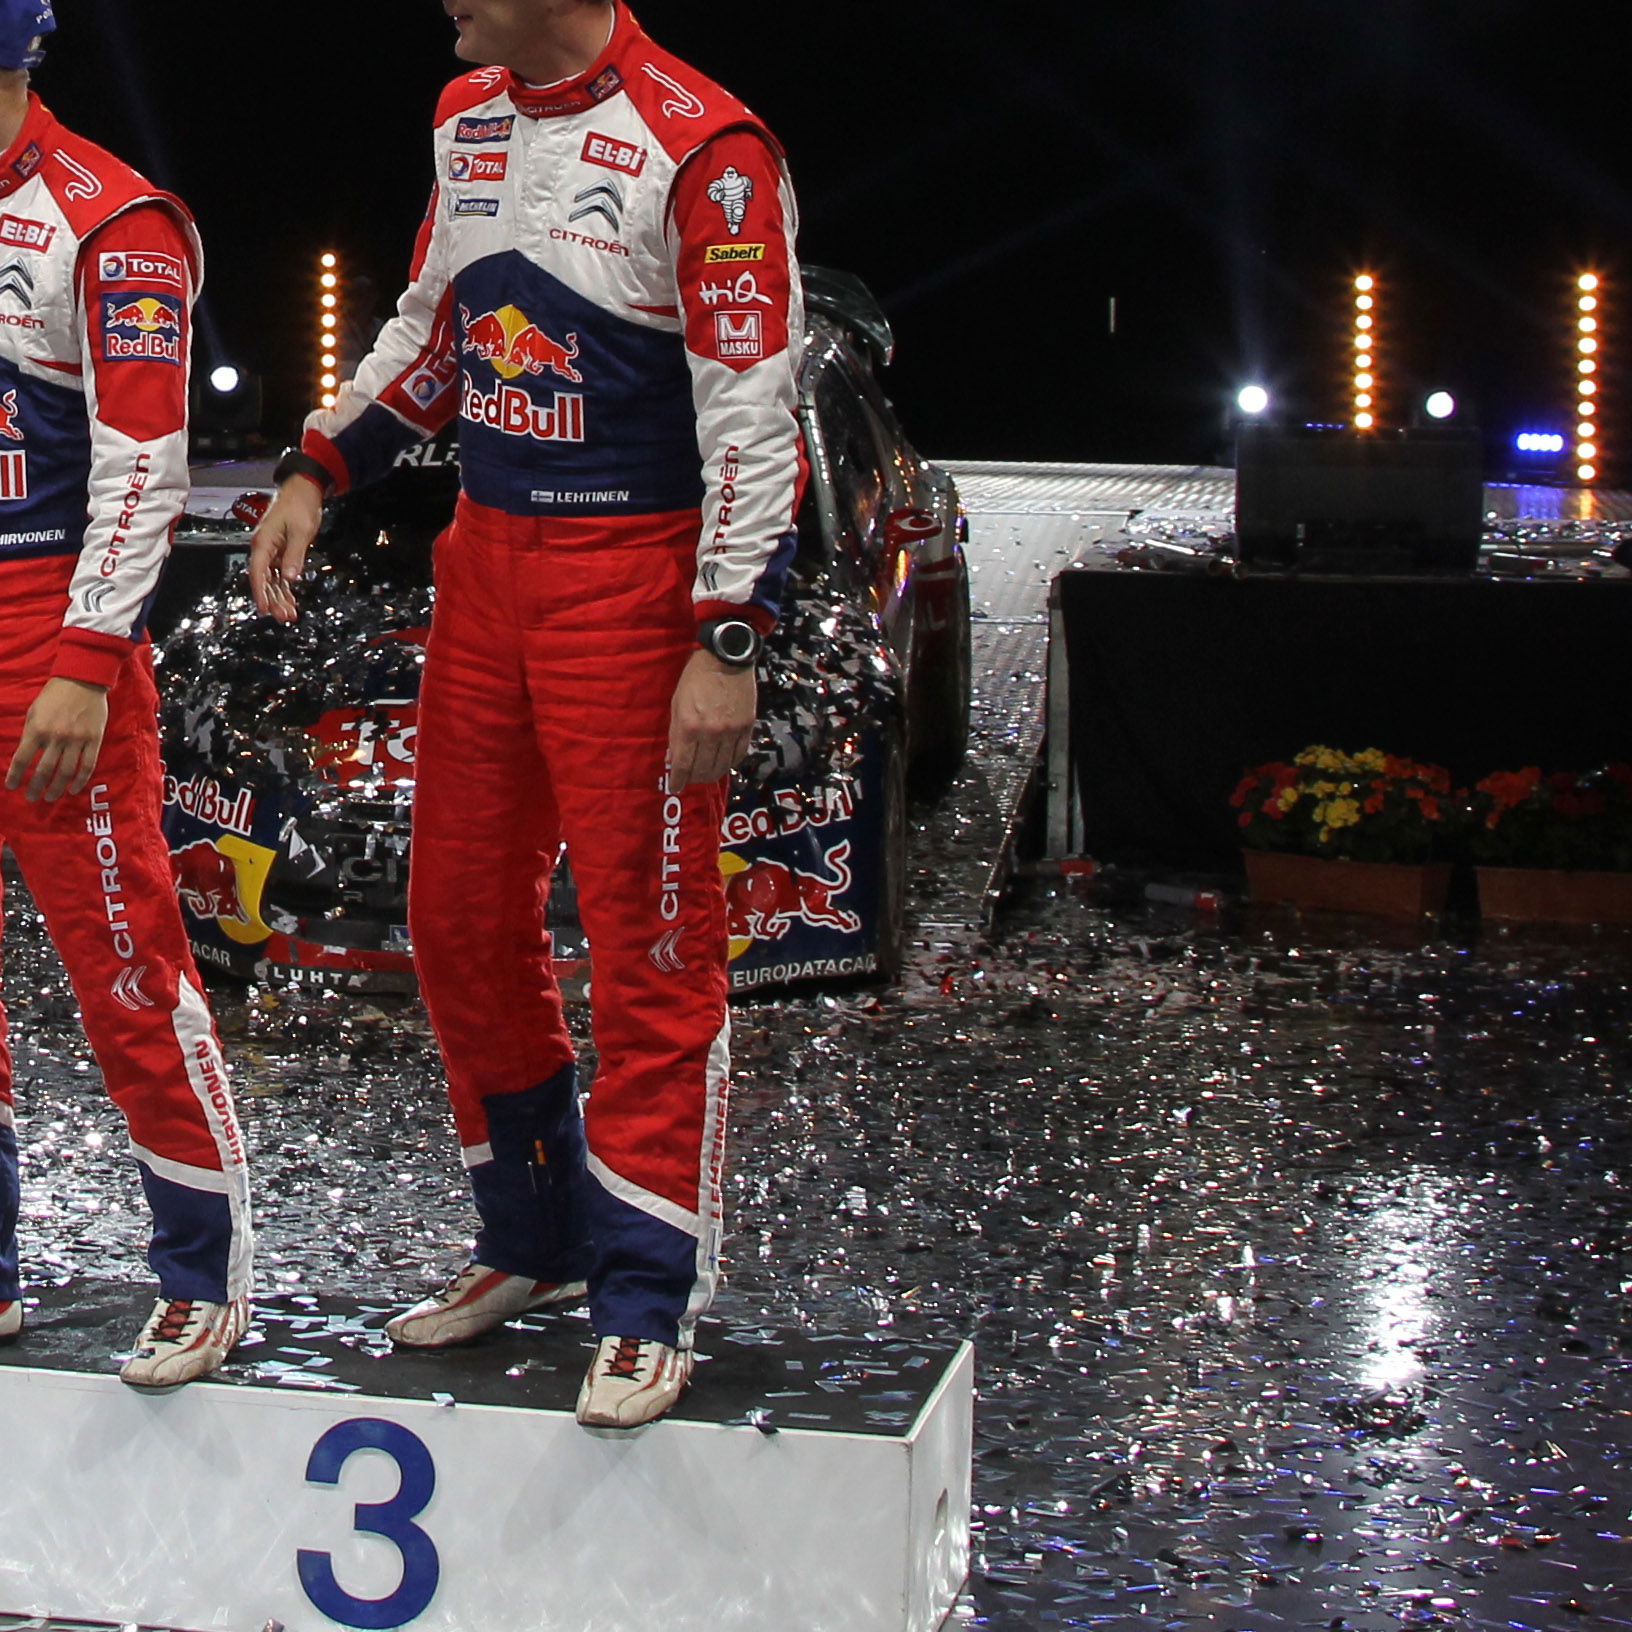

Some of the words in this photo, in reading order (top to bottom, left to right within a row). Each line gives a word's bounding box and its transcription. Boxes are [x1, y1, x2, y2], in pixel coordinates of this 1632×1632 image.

[474, 158, 504, 174] TOTAL
[458, 200, 498, 213] MICHELIN
[710, 246, 761, 261] Sabelt
[128, 259, 180, 280] TOTAL
[720, 341, 759, 355] MASKU
[556, 490, 629, 503] LEHTINEN
[195, 1040, 244, 1165] HIRVONEN
[296, 1417, 440, 1631] 3
